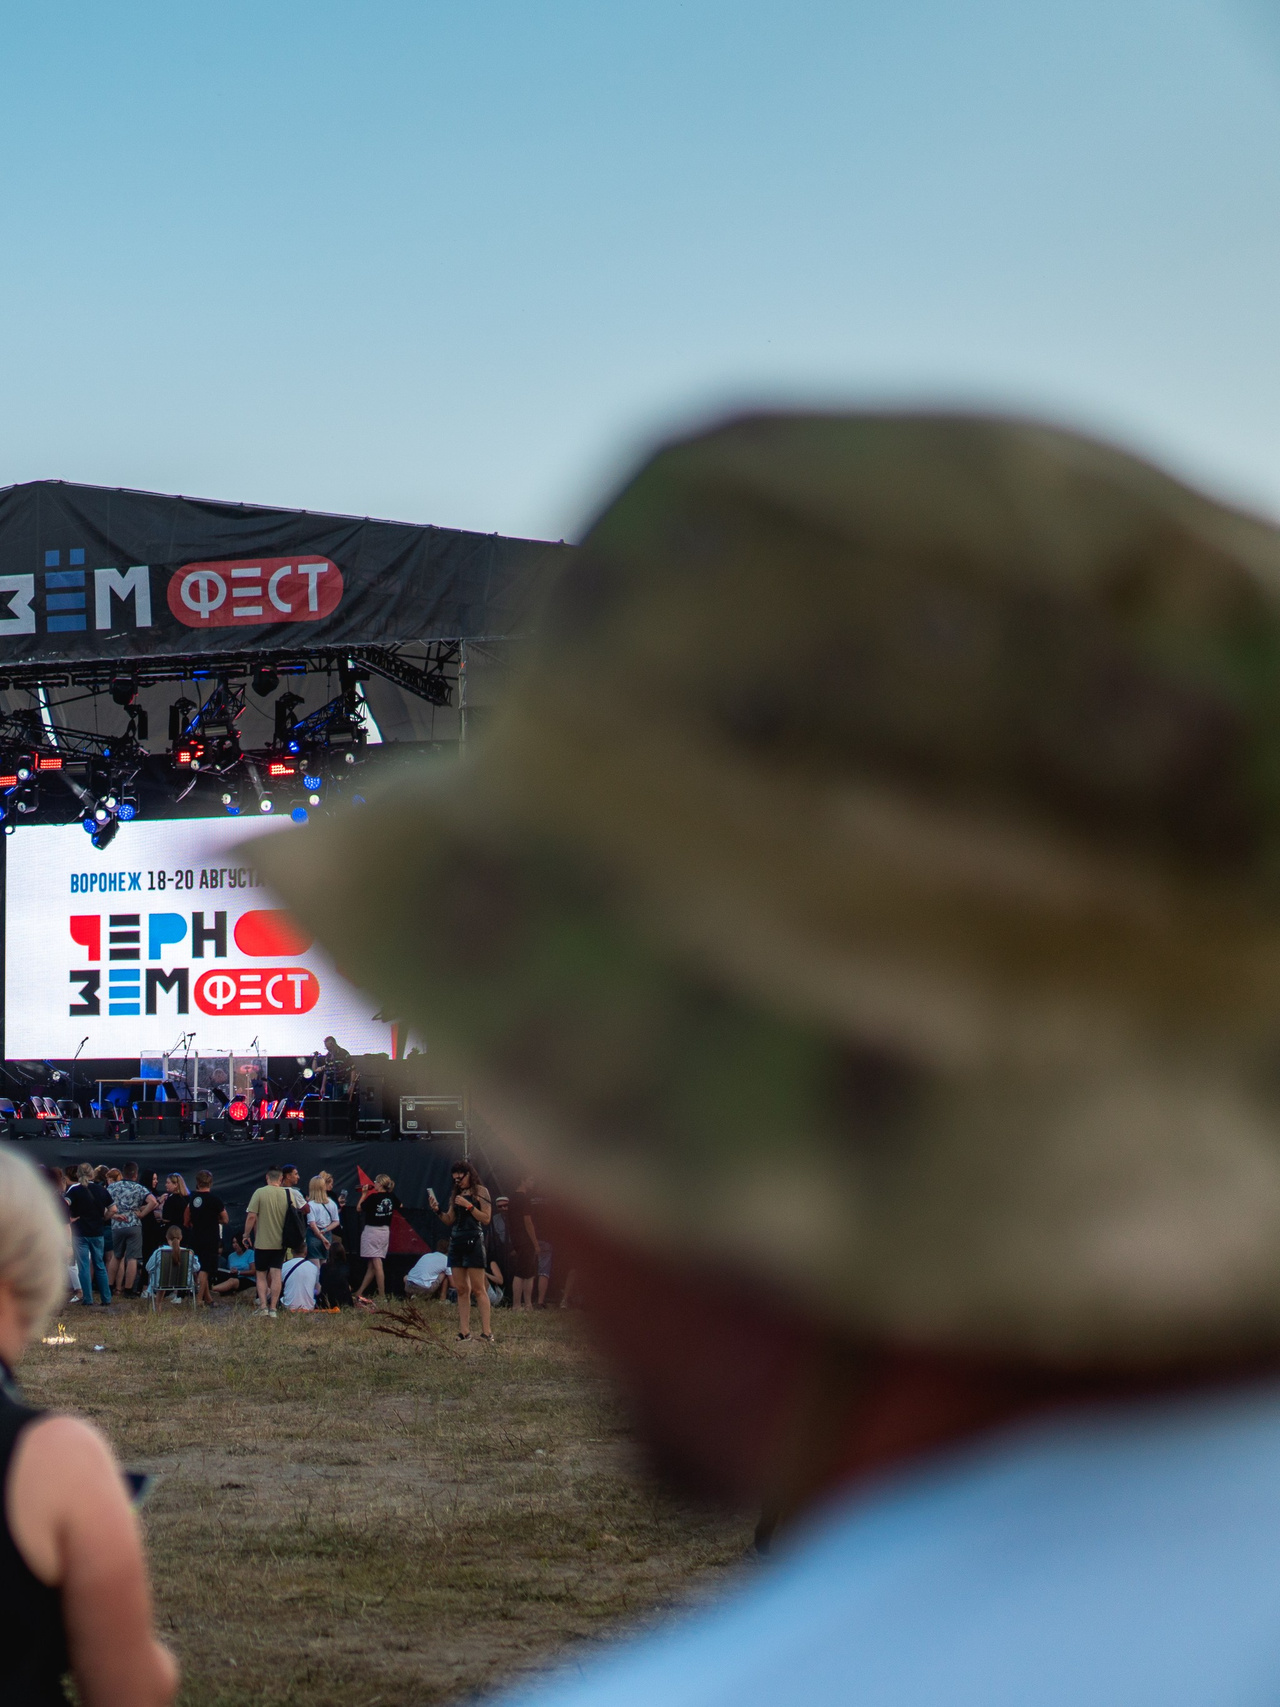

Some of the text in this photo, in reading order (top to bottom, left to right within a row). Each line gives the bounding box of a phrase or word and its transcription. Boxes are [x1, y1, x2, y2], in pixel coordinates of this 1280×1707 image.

[180, 563, 330, 618] ФЕСТ
[69, 866, 266, 893] ВОРОНЕЖ 18-20 АВГУСТ
[69, 909, 317, 961] ЧЕРНО
[69, 967, 309, 1017] ЗЕМ ФЕСТ
